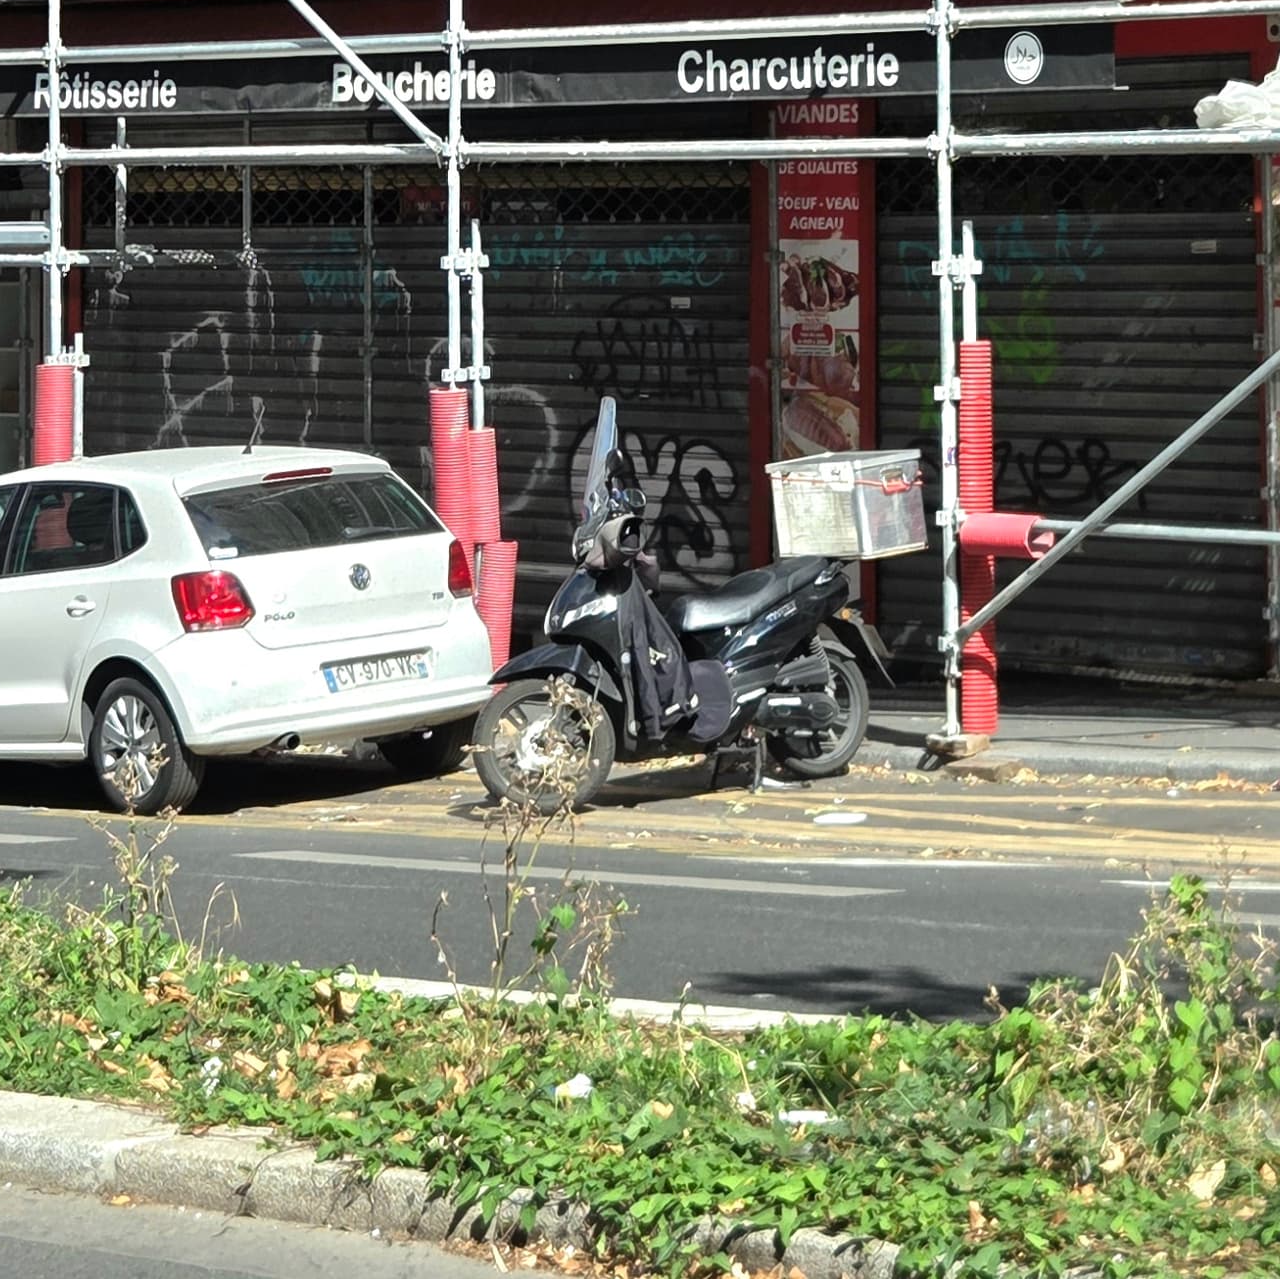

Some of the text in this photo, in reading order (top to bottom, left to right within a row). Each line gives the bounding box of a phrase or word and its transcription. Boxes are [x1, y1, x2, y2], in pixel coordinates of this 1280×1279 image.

[677, 41, 900, 94] Charcuterie
[33, 69, 178, 110] Rôtisserie
[777, 104, 860, 124] VIANDES
[778, 161, 859, 175] DE QUALITES
[825, 197, 860, 211] VEAU
[789, 216, 845, 231] AGNEAU
[263, 610, 296, 623] POLO
